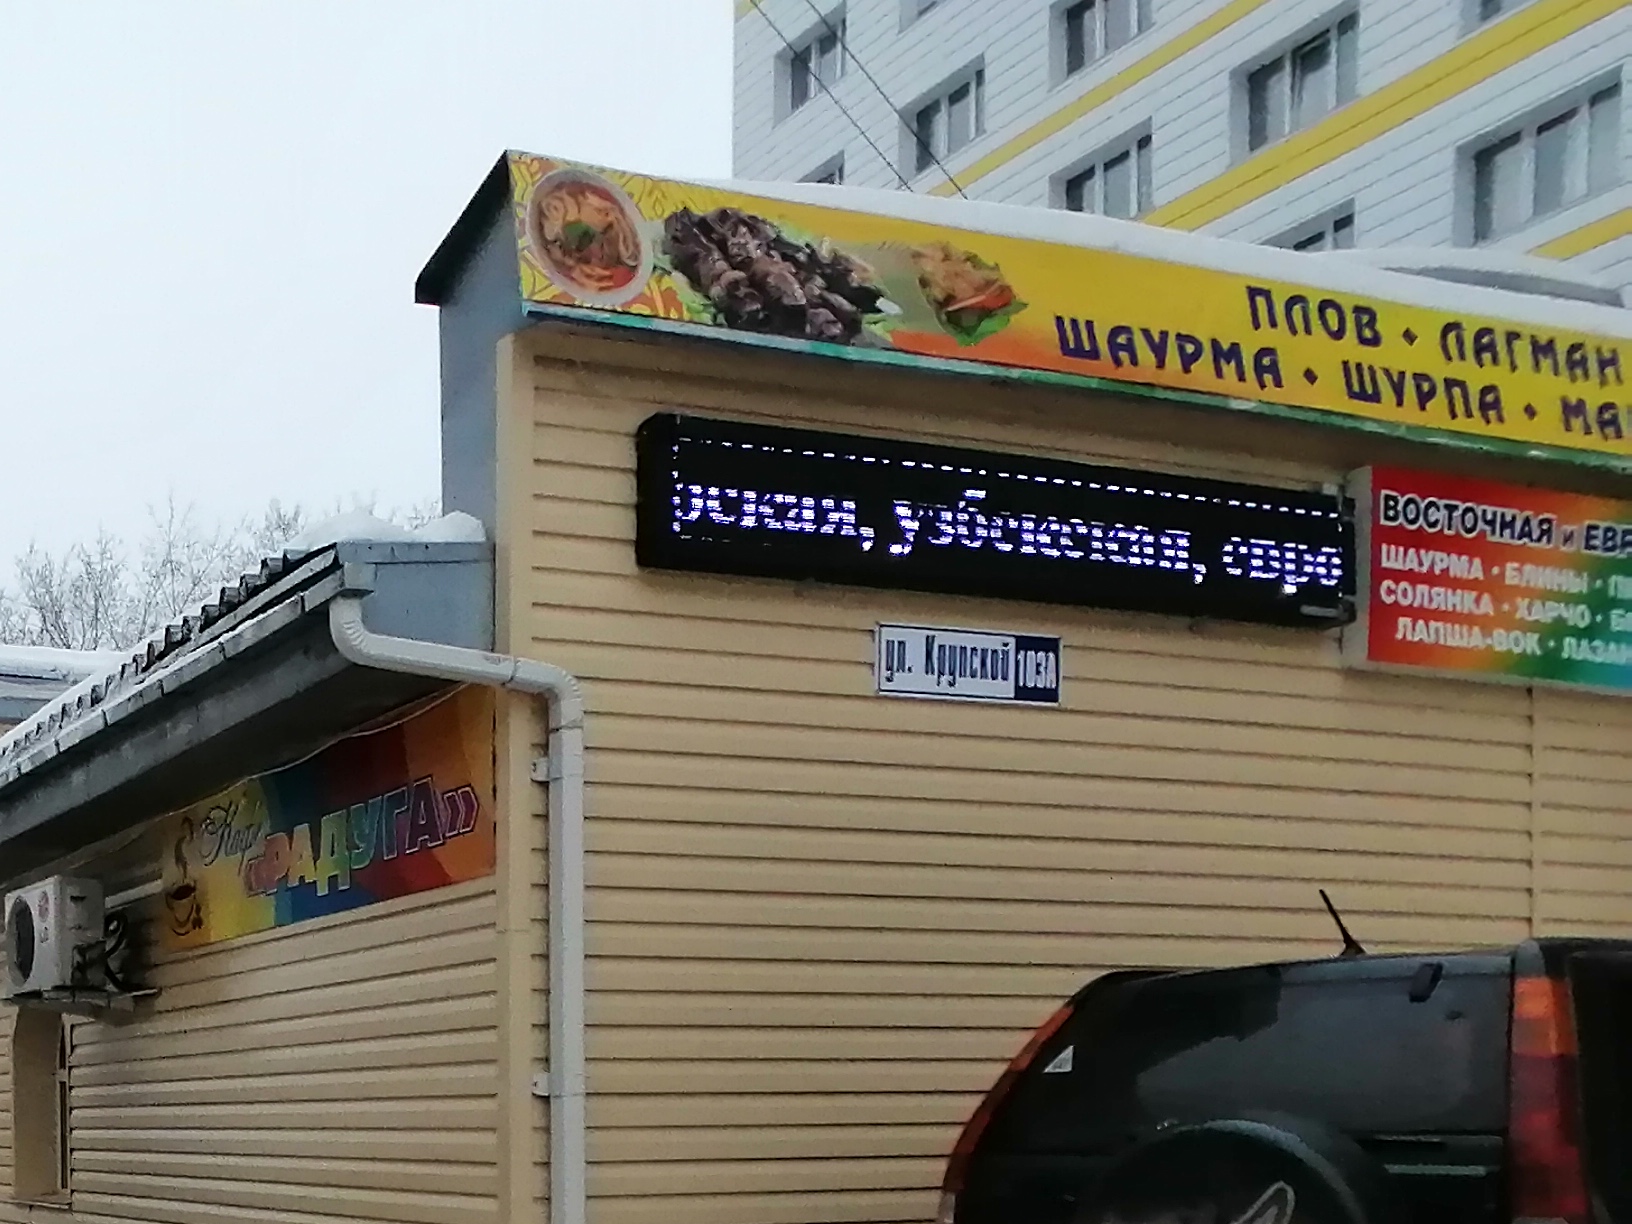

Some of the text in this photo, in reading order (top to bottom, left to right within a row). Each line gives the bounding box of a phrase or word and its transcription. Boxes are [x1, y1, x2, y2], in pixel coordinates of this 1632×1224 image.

[1245, 285, 1624, 388] ПЛОВ ЛАГМАН
[1054, 314, 1284, 391] ШАУРМА
[1341, 359, 1505, 425] ШУРПА
[1381, 490, 1556, 547] ВОСТОЧНАЯ
[1380, 544, 1484, 581] ШАУРМА
[1379, 579, 1495, 616] СОЛЯНКА
[885, 634, 1058, 689] ул. Крупской 103А
[1395, 617, 1542, 656] ЛАПША-ВОК
